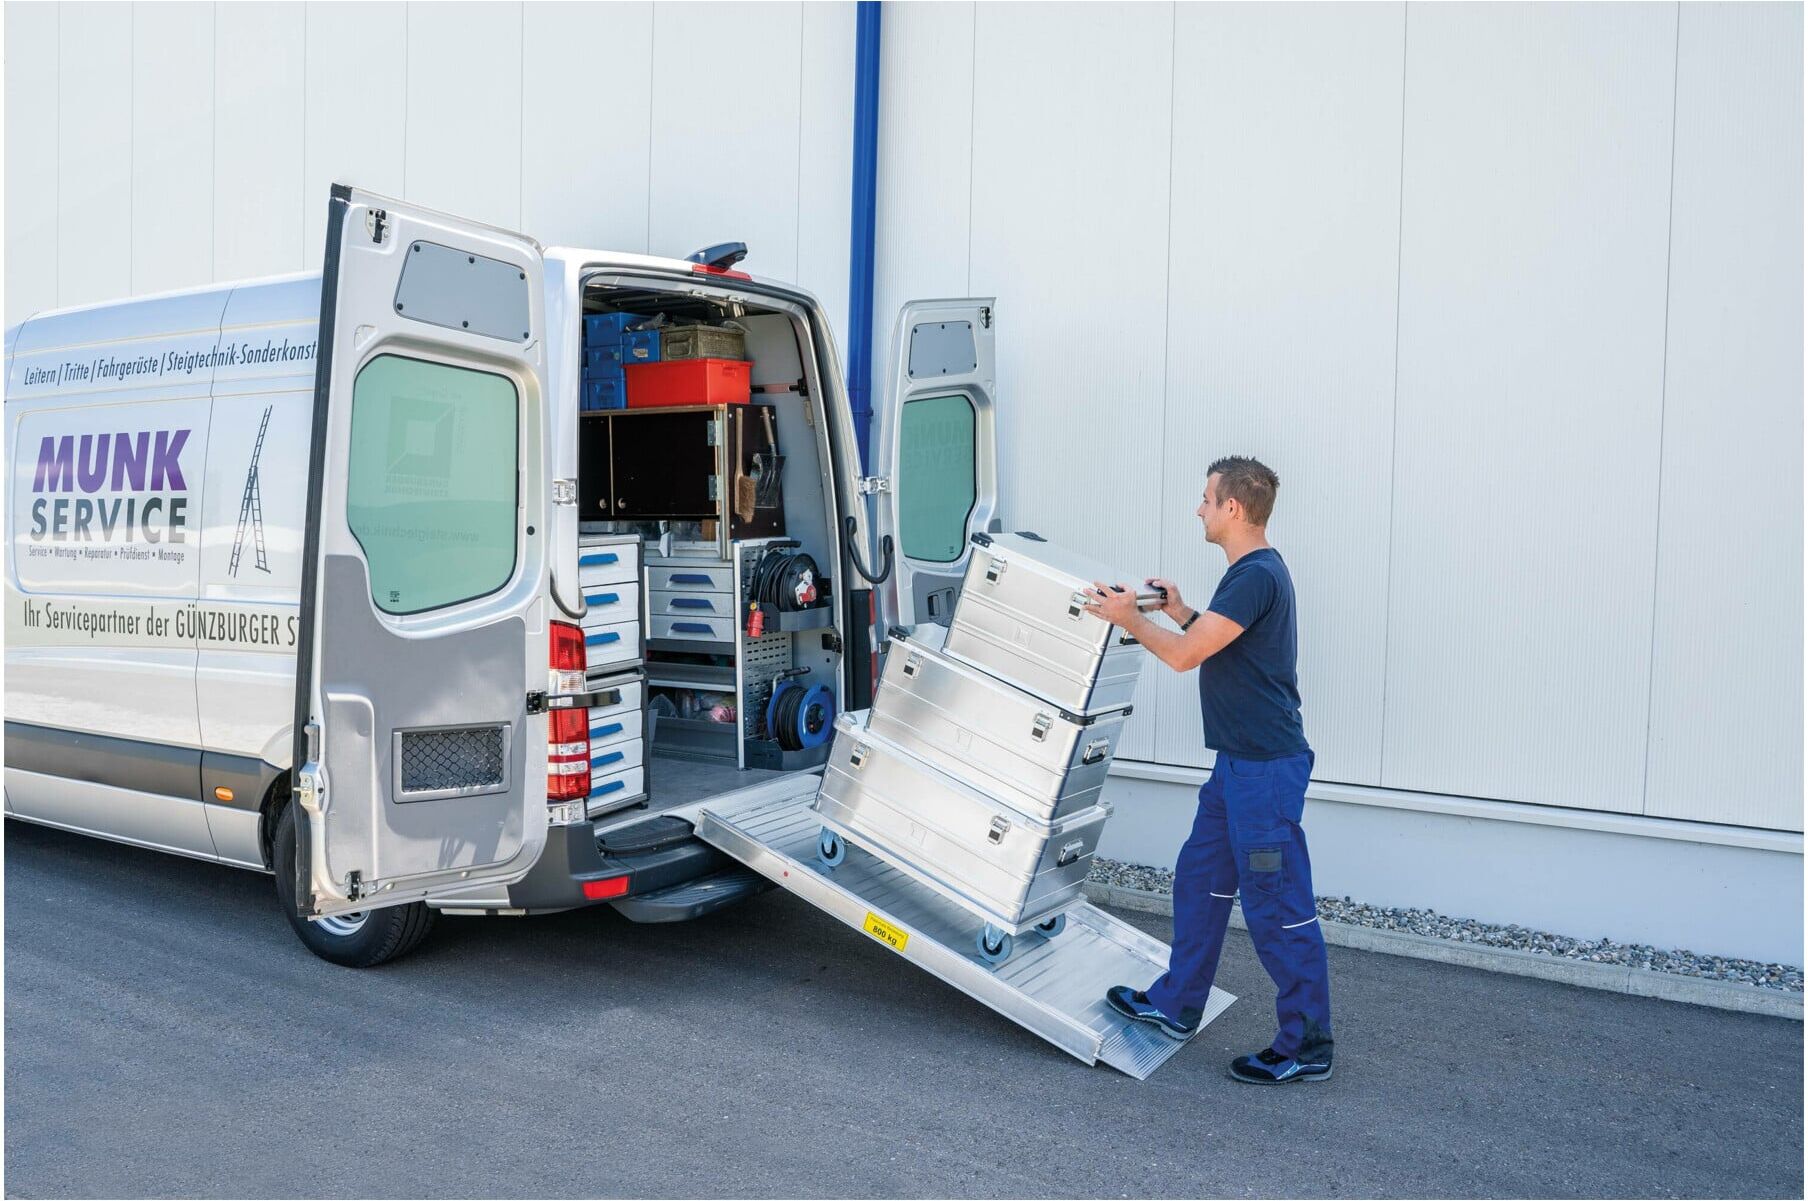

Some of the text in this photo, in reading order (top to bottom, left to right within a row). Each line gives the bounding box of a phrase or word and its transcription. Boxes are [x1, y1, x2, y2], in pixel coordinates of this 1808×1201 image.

[24, 367, 56, 386] Leitern
[64, 363, 89, 381] Tritte
[97, 356, 158, 382] Fahrgerüste
[32, 429, 191, 494] MUNK
[30, 497, 187, 545] SERVICE
[29, 545, 184, 564] Service Wartung Reparatur Prüfdienst Montage
[24, 600, 300, 646] Ihr Servicepartner der GÜNZBURGER S
[872, 925, 887, 938] 800
[888, 934, 897, 946] kg
